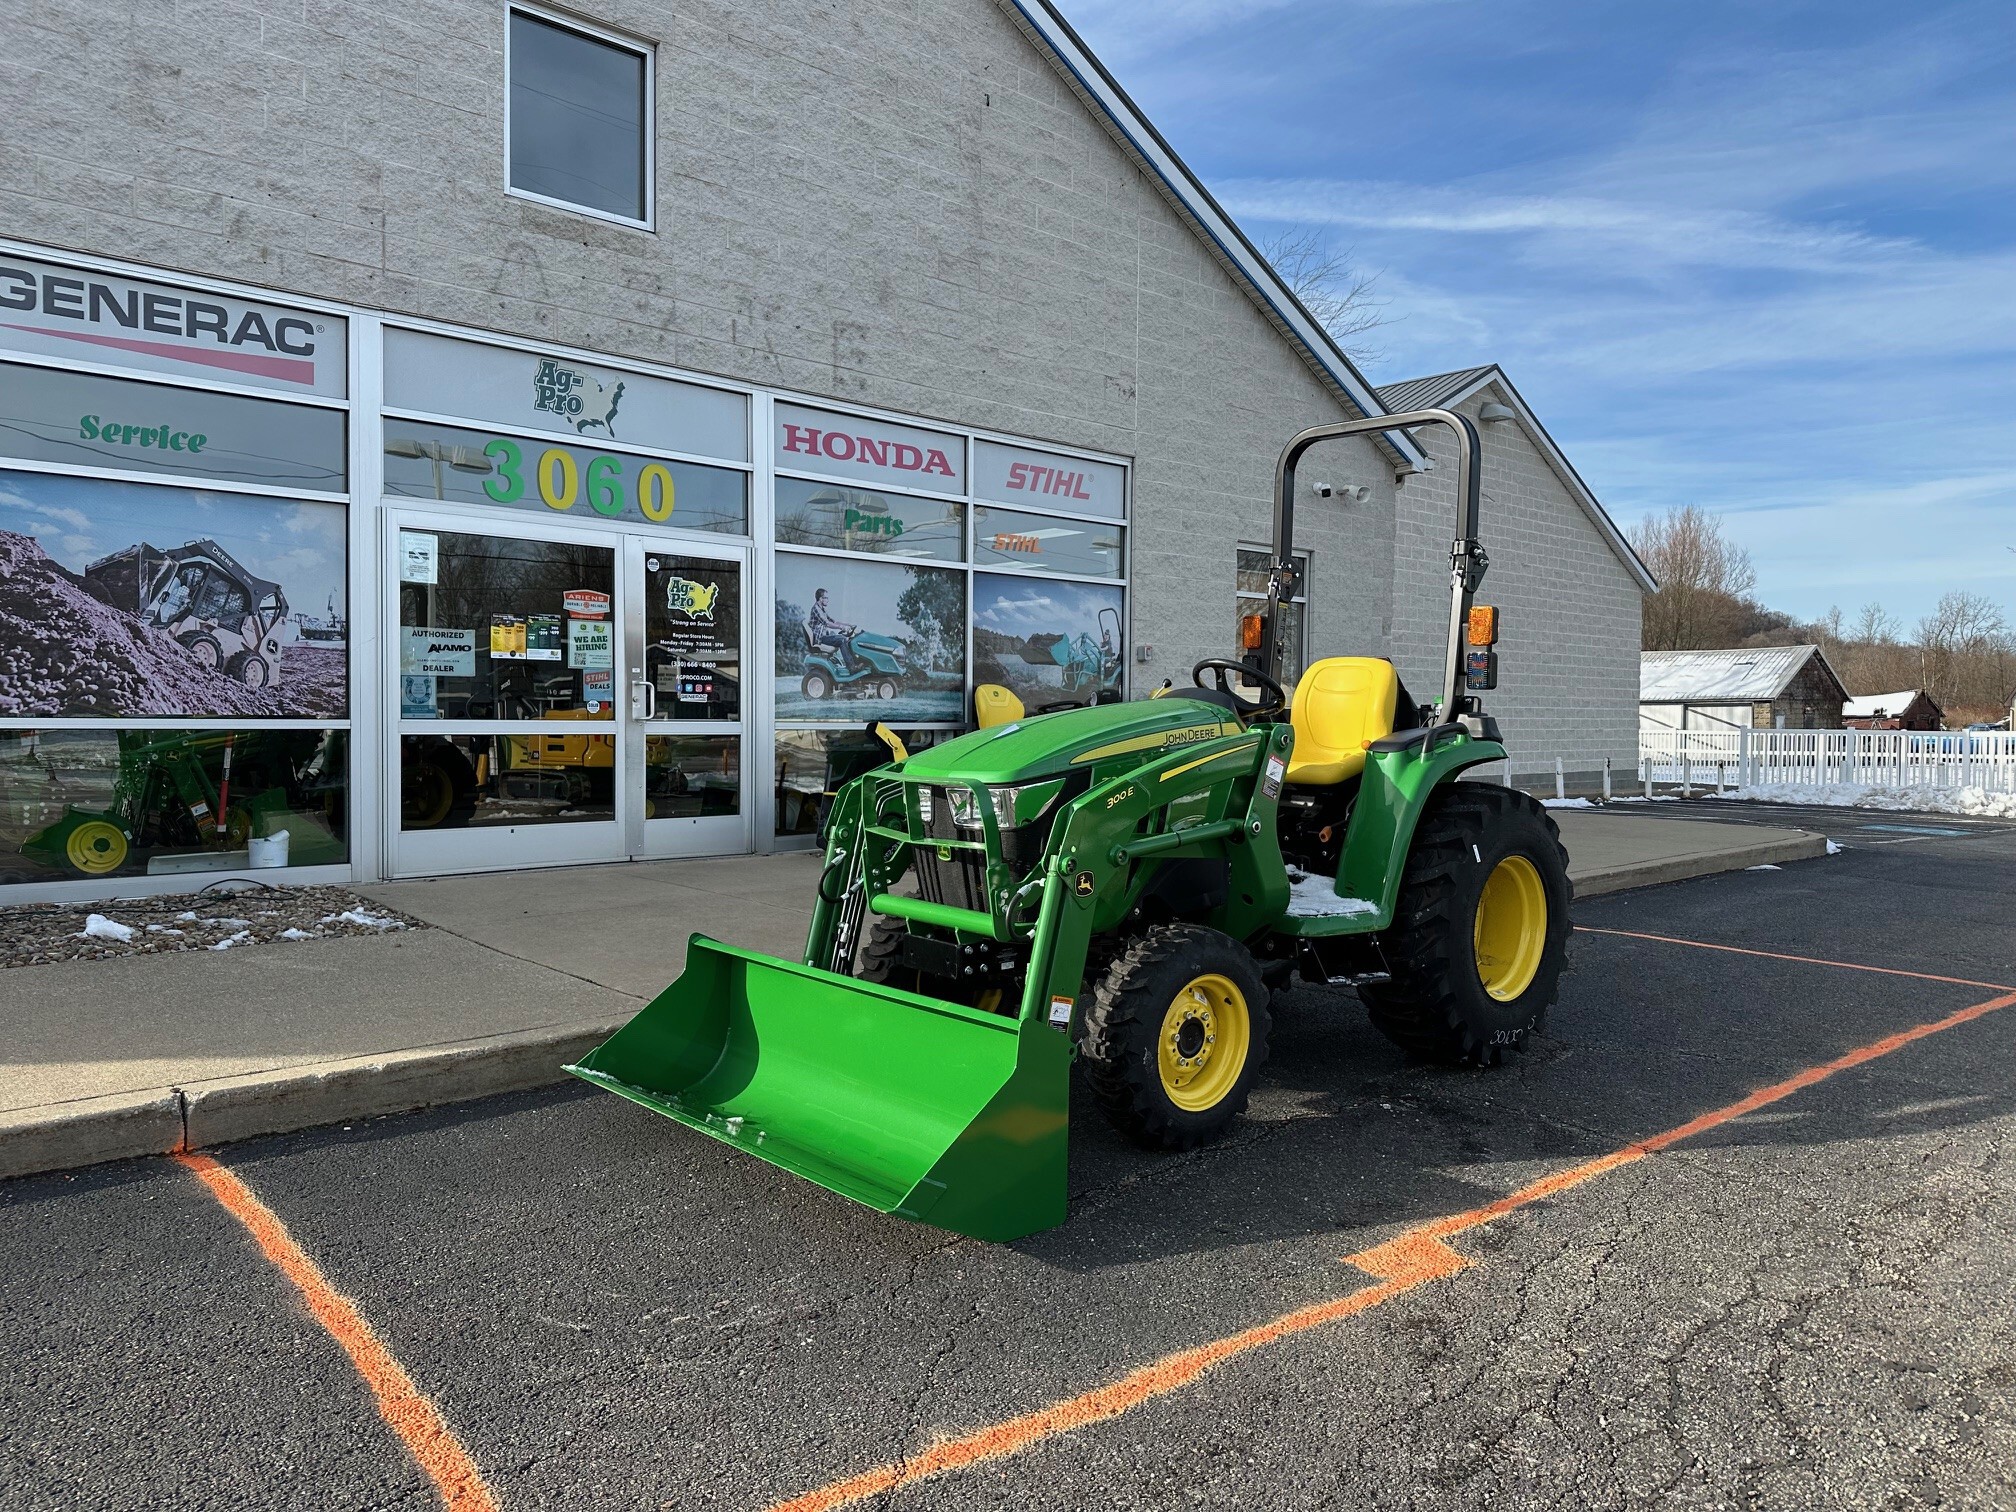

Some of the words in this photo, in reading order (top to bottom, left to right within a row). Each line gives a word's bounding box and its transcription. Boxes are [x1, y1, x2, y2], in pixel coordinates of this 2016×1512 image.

[0, 266, 315, 357] GENERAC
[536, 385, 582, 414] Pro
[80, 414, 208, 453] Service
[782, 424, 956, 477] HONDA
[482, 439, 675, 522] 3060
[1006, 461, 1091, 500] STIHL
[844, 508, 904, 537] Parts
[992, 532, 1043, 554] STIHL
[211, 546, 235, 568] DEERE
[568, 594, 605, 602] ARIENS
[670, 593, 694, 607] Pro
[412, 629, 465, 639] AUTHORIZED
[573, 636, 589, 644] WE
[590, 635, 608, 643] ARE
[428, 643, 472, 654] ALAMO
[575, 643, 608, 651] HIRING
[586, 672, 609, 682] STIHL
[1162, 732, 1187, 746] JOHN
[1187, 729, 1216, 741] DEERE
